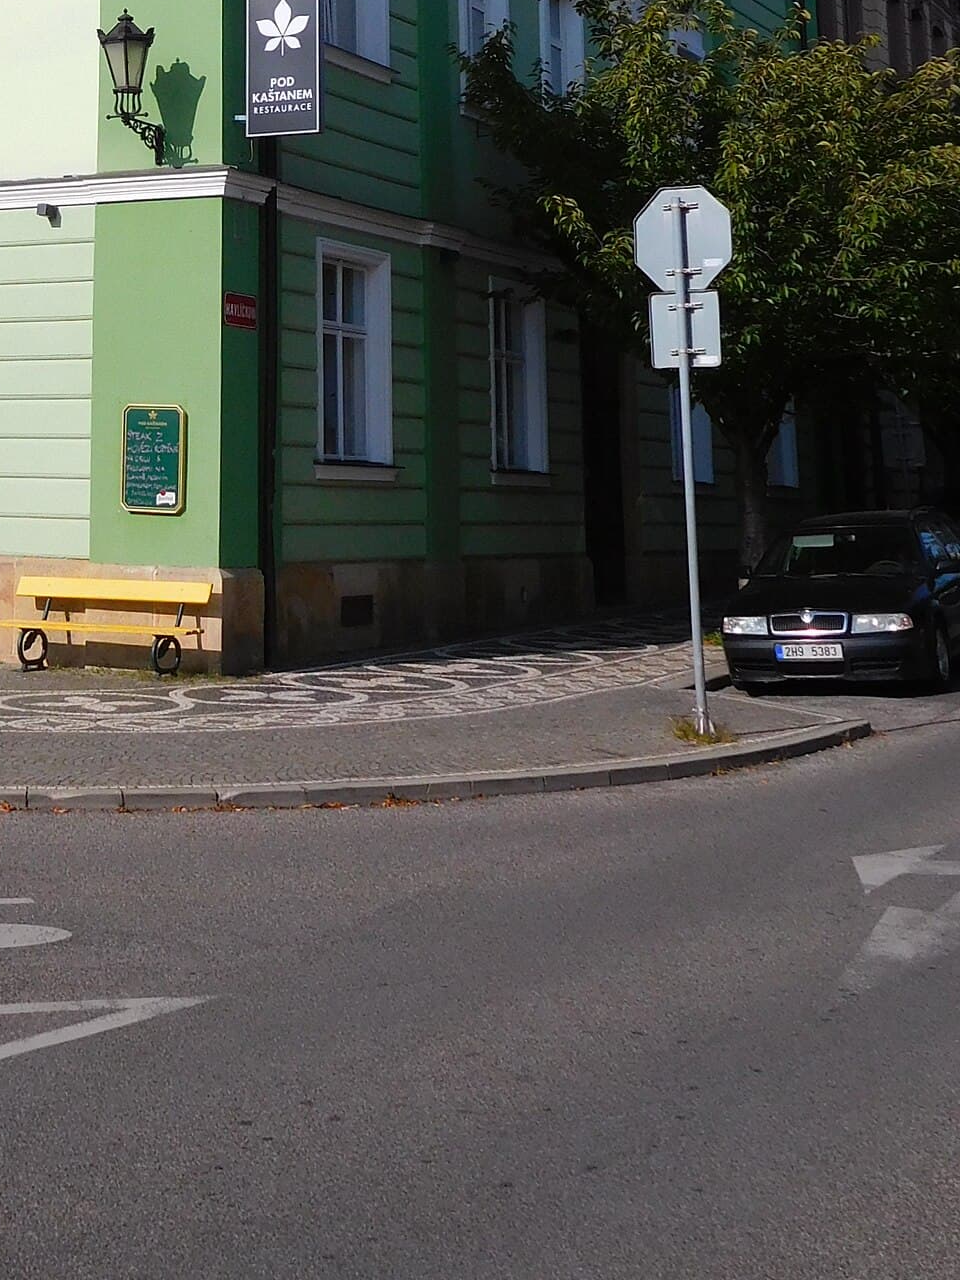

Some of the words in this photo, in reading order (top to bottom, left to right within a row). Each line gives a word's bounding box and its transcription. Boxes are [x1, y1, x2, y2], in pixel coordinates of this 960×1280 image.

[270, 76, 295, 88] POD
[252, 88, 313, 104] KAŠTANEM
[253, 102, 312, 114] RESTAURACE
[784, 646, 805, 657] 2H9
[811, 646, 837, 657] 5383
